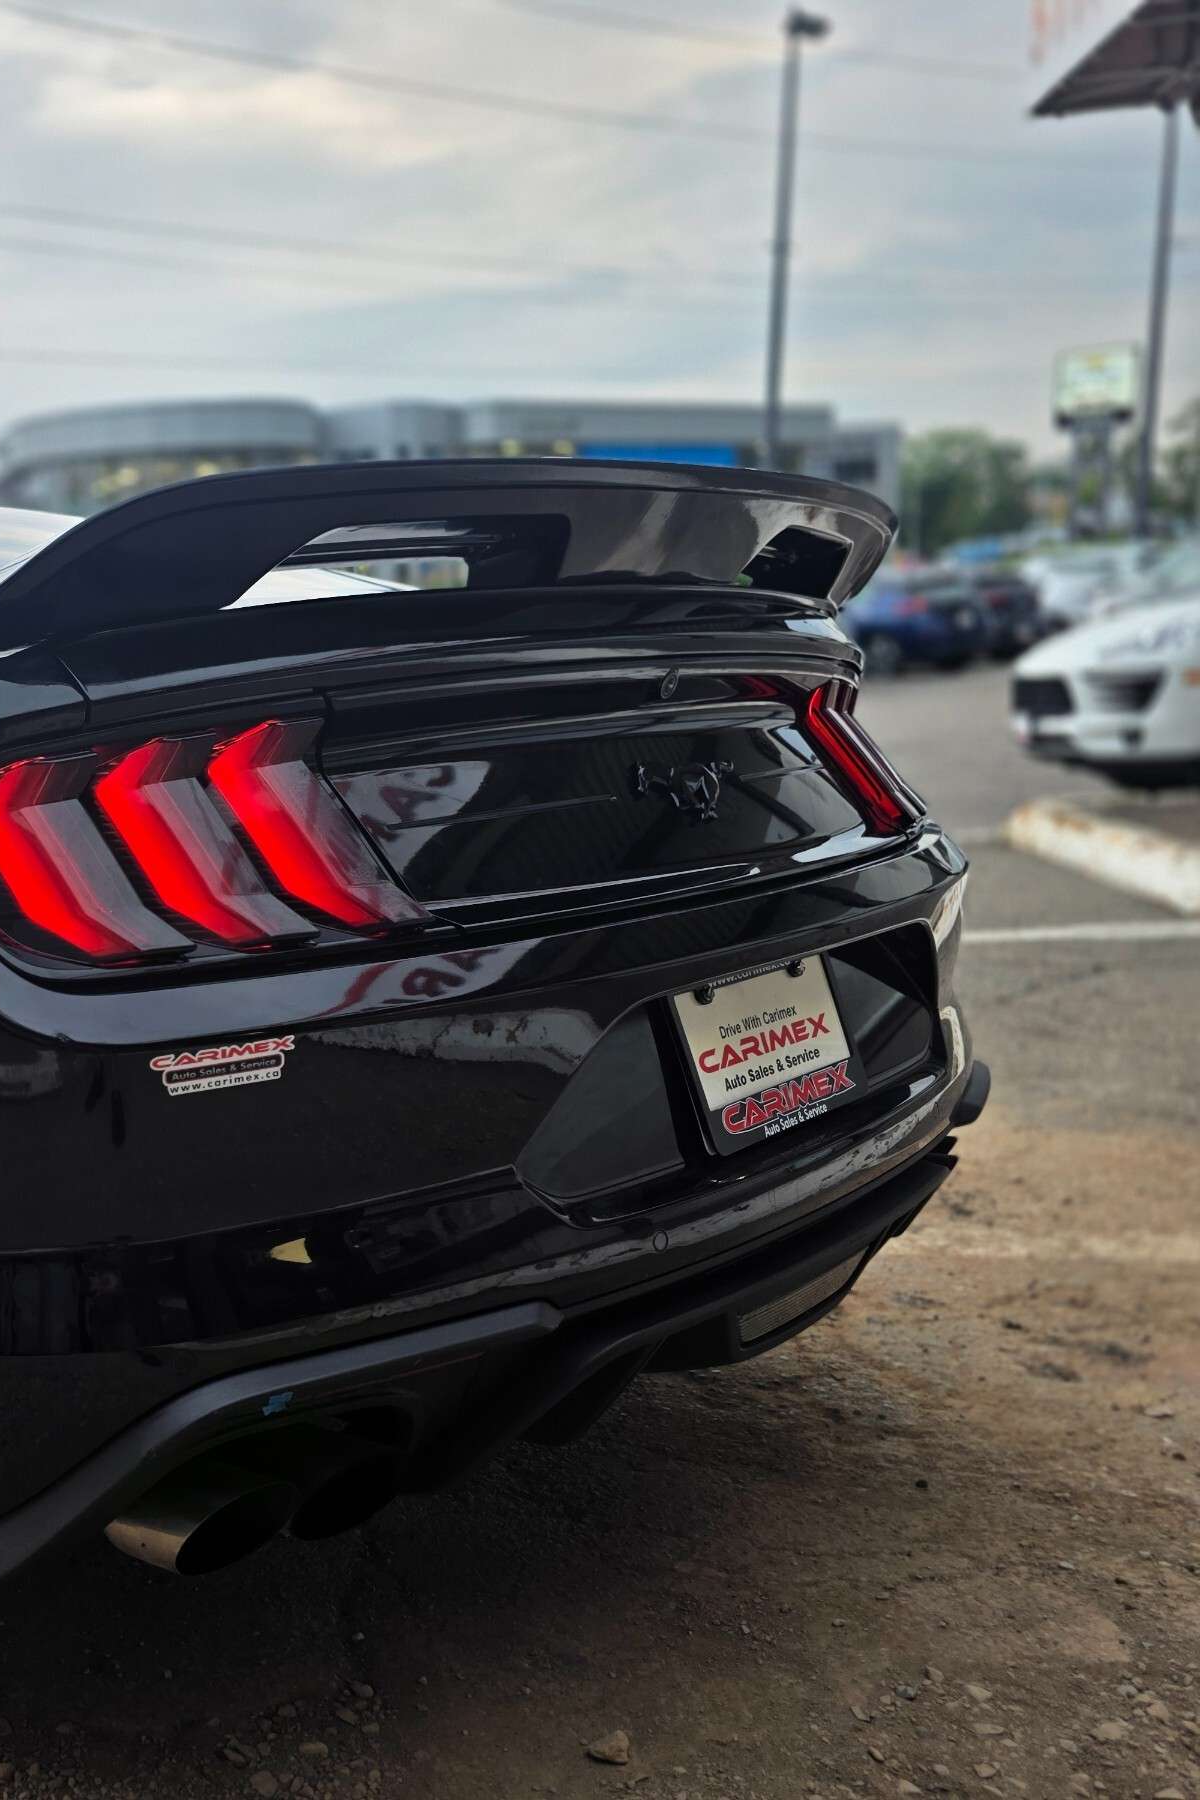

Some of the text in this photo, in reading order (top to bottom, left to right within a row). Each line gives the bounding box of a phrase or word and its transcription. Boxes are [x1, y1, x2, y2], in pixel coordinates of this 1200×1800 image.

[719, 1005, 798, 1039] Drive With Carimex
[151, 1036, 294, 1069] CARIMEX
[699, 1013, 831, 1074] CARIMEX
[170, 1070, 280, 1094] www.carimex.ca
[171, 1058, 276, 1082] Auto Sales & Service
[724, 1047, 821, 1092] Auto Sales & Service
[723, 1062, 855, 1134] CARIMEX
[764, 1103, 828, 1138] Auto Sales & Service
